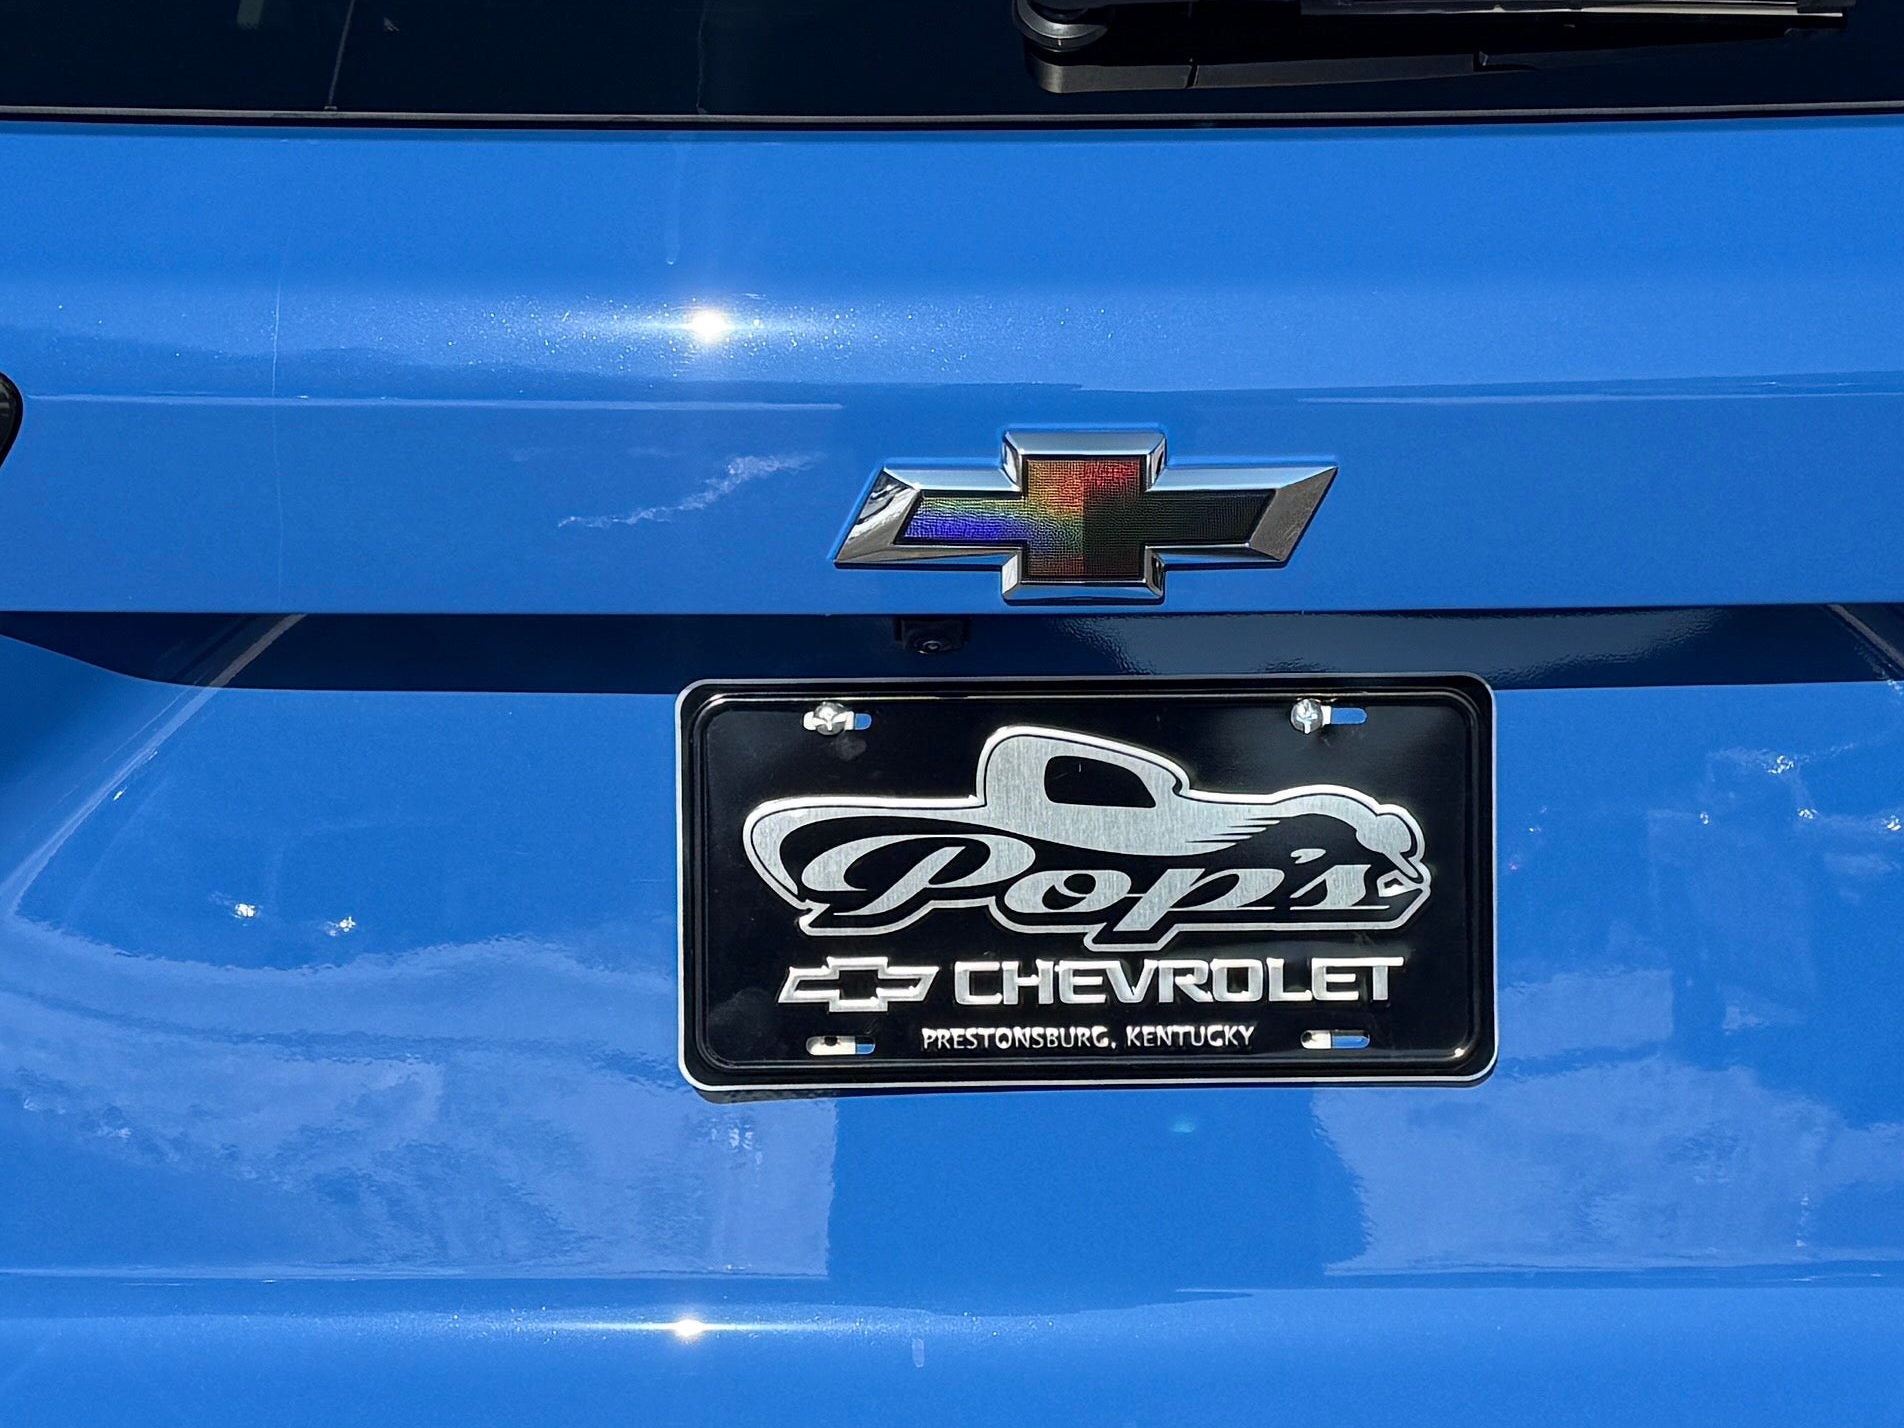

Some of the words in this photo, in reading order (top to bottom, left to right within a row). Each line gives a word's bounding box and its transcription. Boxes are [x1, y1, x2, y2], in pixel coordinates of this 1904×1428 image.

[801, 832, 1390, 932] Pop's
[954, 955, 1405, 1008] CHEVROLET
[921, 1026, 1117, 1052] PRESTONSBURG,
[1126, 1023, 1256, 1050] KENTUCKY
